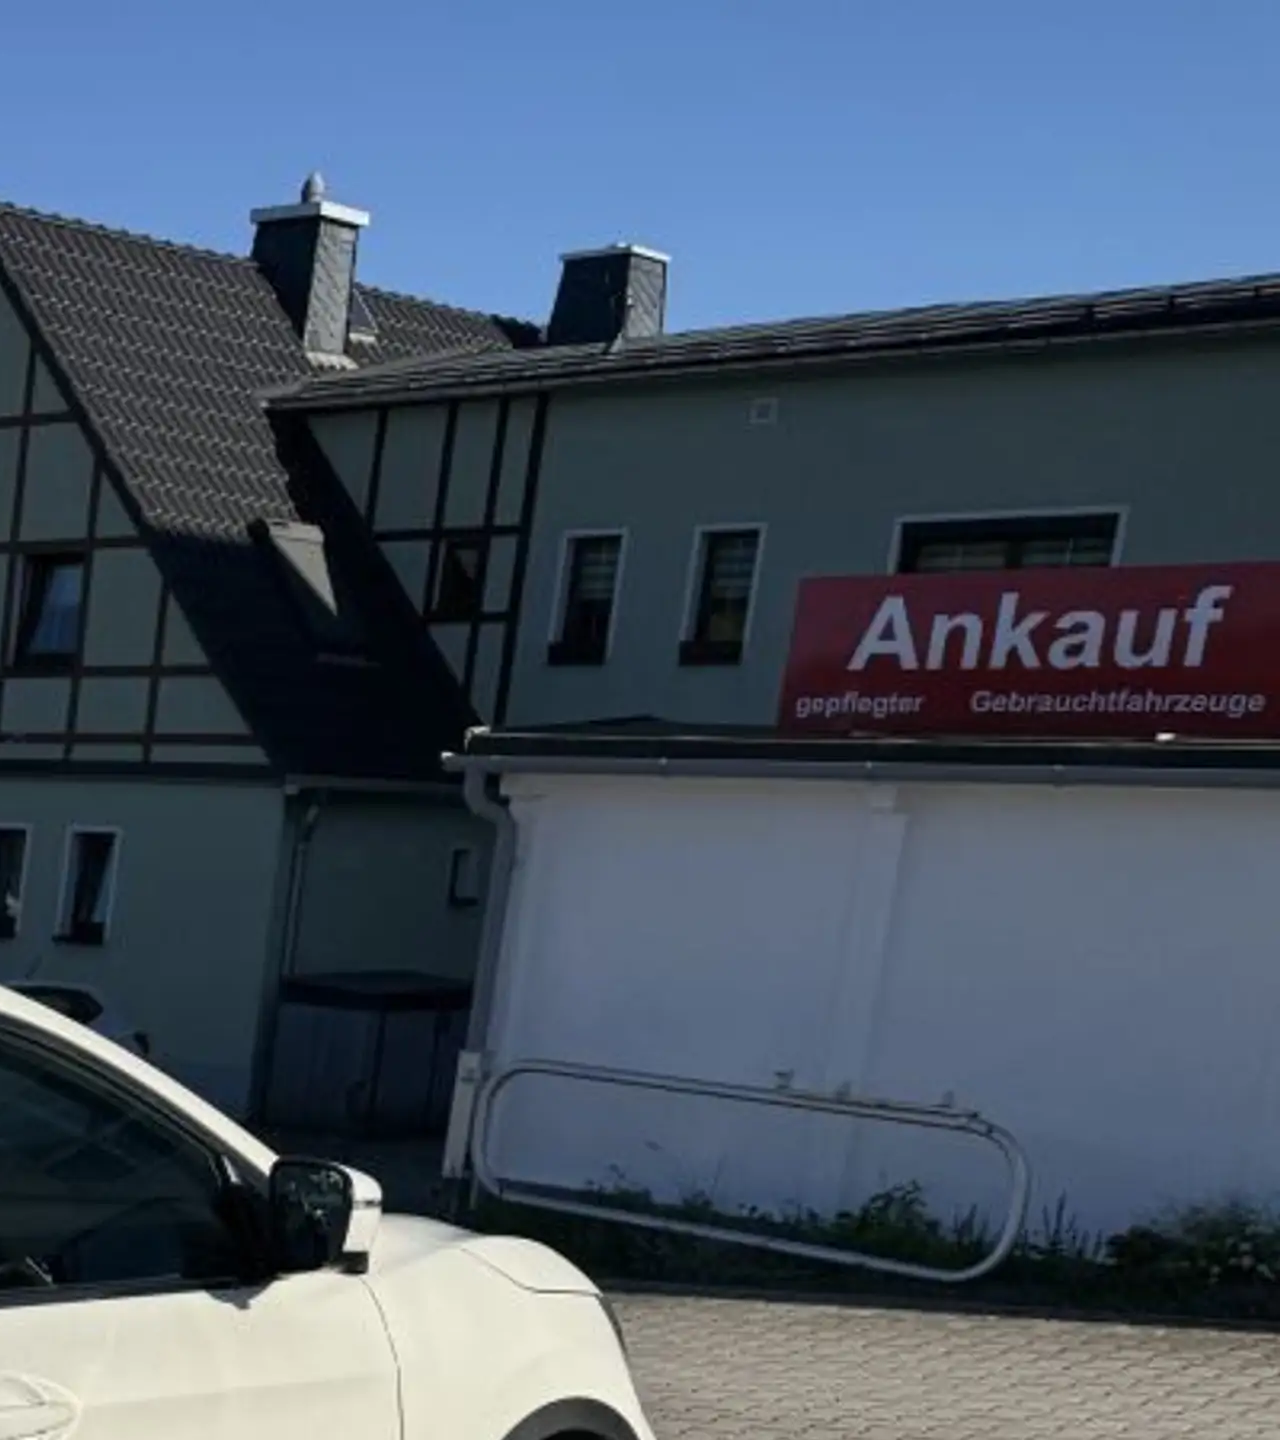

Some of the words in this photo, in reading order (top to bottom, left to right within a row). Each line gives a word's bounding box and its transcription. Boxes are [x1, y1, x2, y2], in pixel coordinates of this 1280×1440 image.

[846, 584, 1233, 671] Ankauf
[795, 690, 924, 718] gepflegter
[969, 688, 1266, 718] Gebrauchtfahrzeuge
